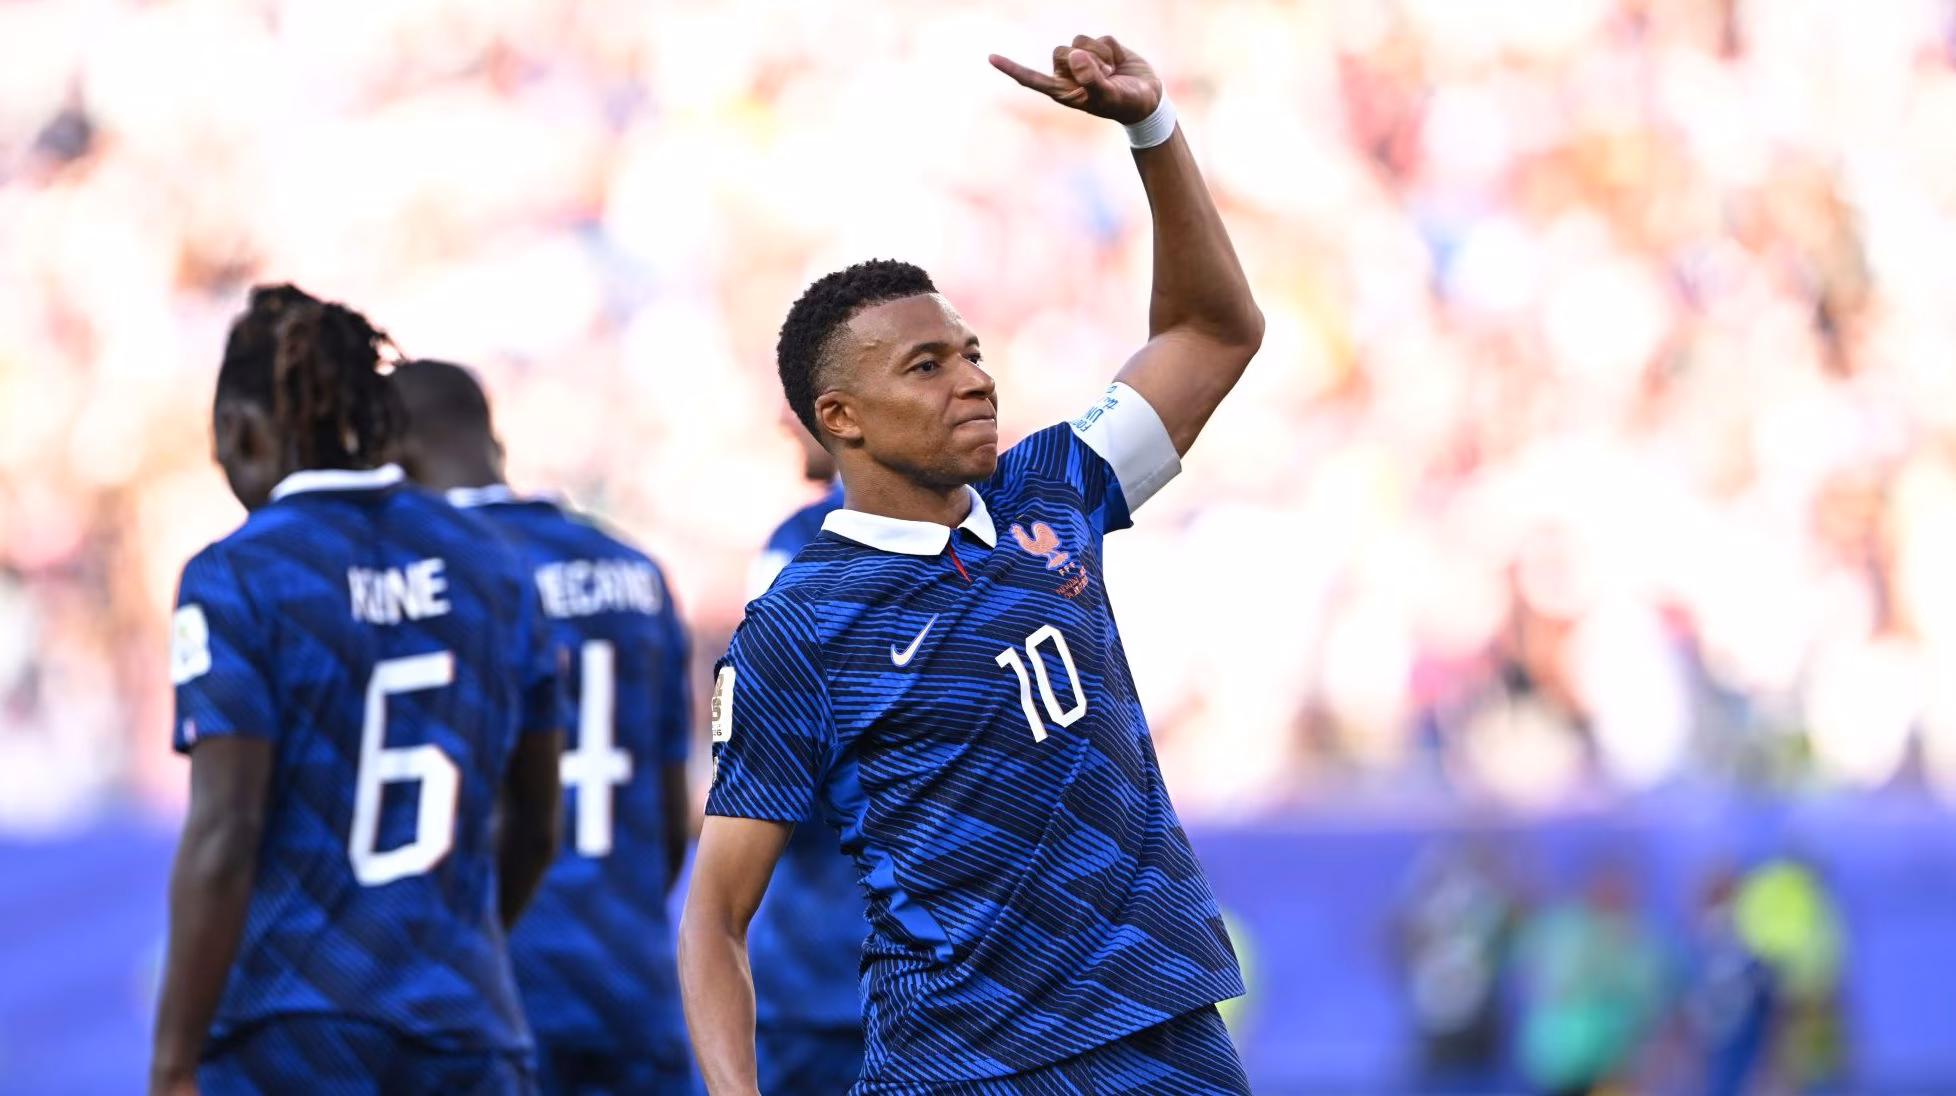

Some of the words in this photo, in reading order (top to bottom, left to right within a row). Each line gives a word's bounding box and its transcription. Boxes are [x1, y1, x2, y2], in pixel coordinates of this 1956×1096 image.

[349, 649, 460, 887] 6
[559, 639, 633, 858] 4
[995, 624, 1087, 743] 10
